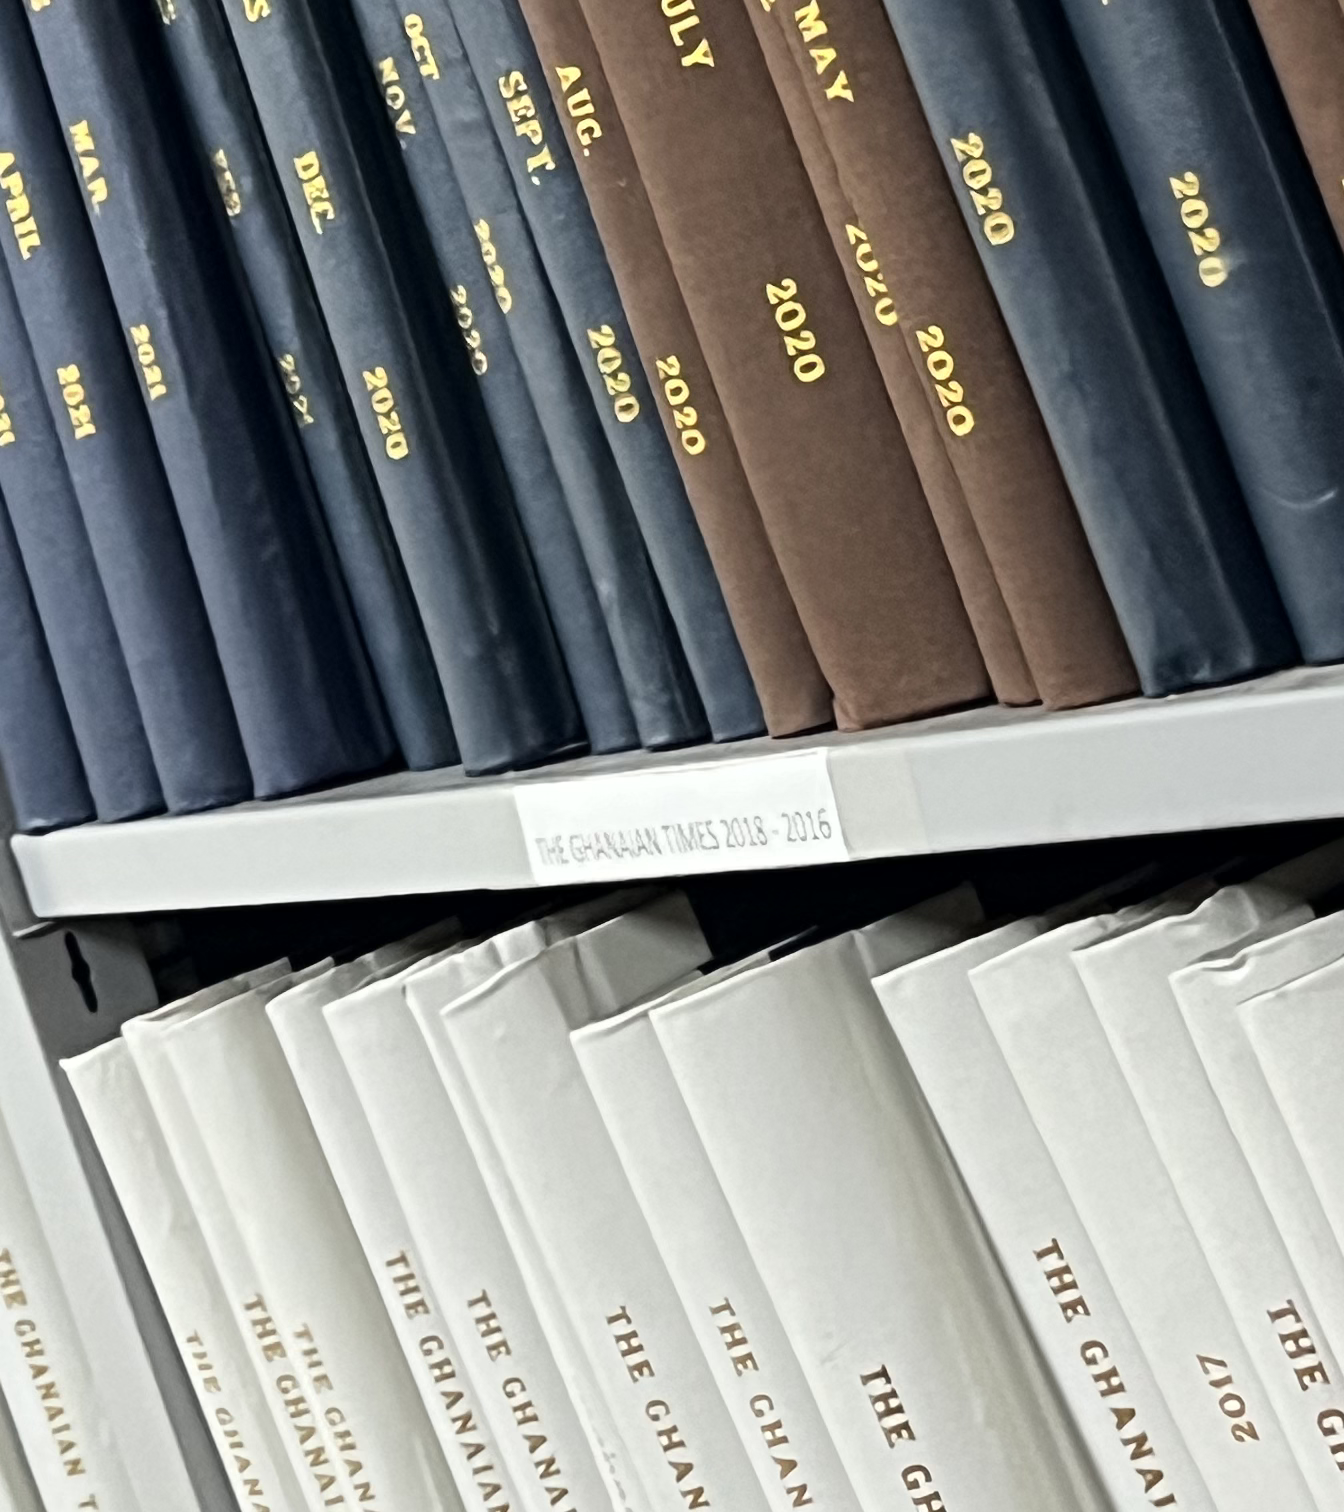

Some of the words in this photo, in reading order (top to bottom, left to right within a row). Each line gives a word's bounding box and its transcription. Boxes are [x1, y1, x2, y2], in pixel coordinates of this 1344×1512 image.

[497, 70, 557, 186] SEPT.
[586, 323, 641, 423] 2020
[949, 131, 1017, 247] 2020
[1169, 170, 1229, 289] 2020
[554, 64, 604, 158] AUG.
[655, 354, 708, 457] 2020
[765, 276, 826, 384] 2020
[914, 323, 976, 438] 2020
[363, 365, 409, 462] 2020
[661, 819, 720, 853] TIMES
[721, 815, 768, 849] 2018
[781, 807, 832, 842] 2016
[385, 1249, 431, 1321] THE
[1266, 1298, 1331, 1392] THE
[13, 1319, 87, 1477] GHANAIAN
[242, 1292, 287, 1363] THE
[275, 1374, 345, 1507] GHANAI
[293, 1323, 334, 1394] THE
[323, 1406, 380, 1512] GHAN
[466, 1289, 513, 1363] THE
[502, 1377, 577, 1512] GHANA
[605, 1305, 656, 1384] THE
[644, 1399, 711, 1511] GHAN
[709, 1297, 760, 1378] THE
[749, 1394, 814, 1510] GHAN
[859, 1364, 917, 1449] THE
[1032, 1237, 1092, 1324] THE
[1079, 1339, 1178, 1509] GHANAI
